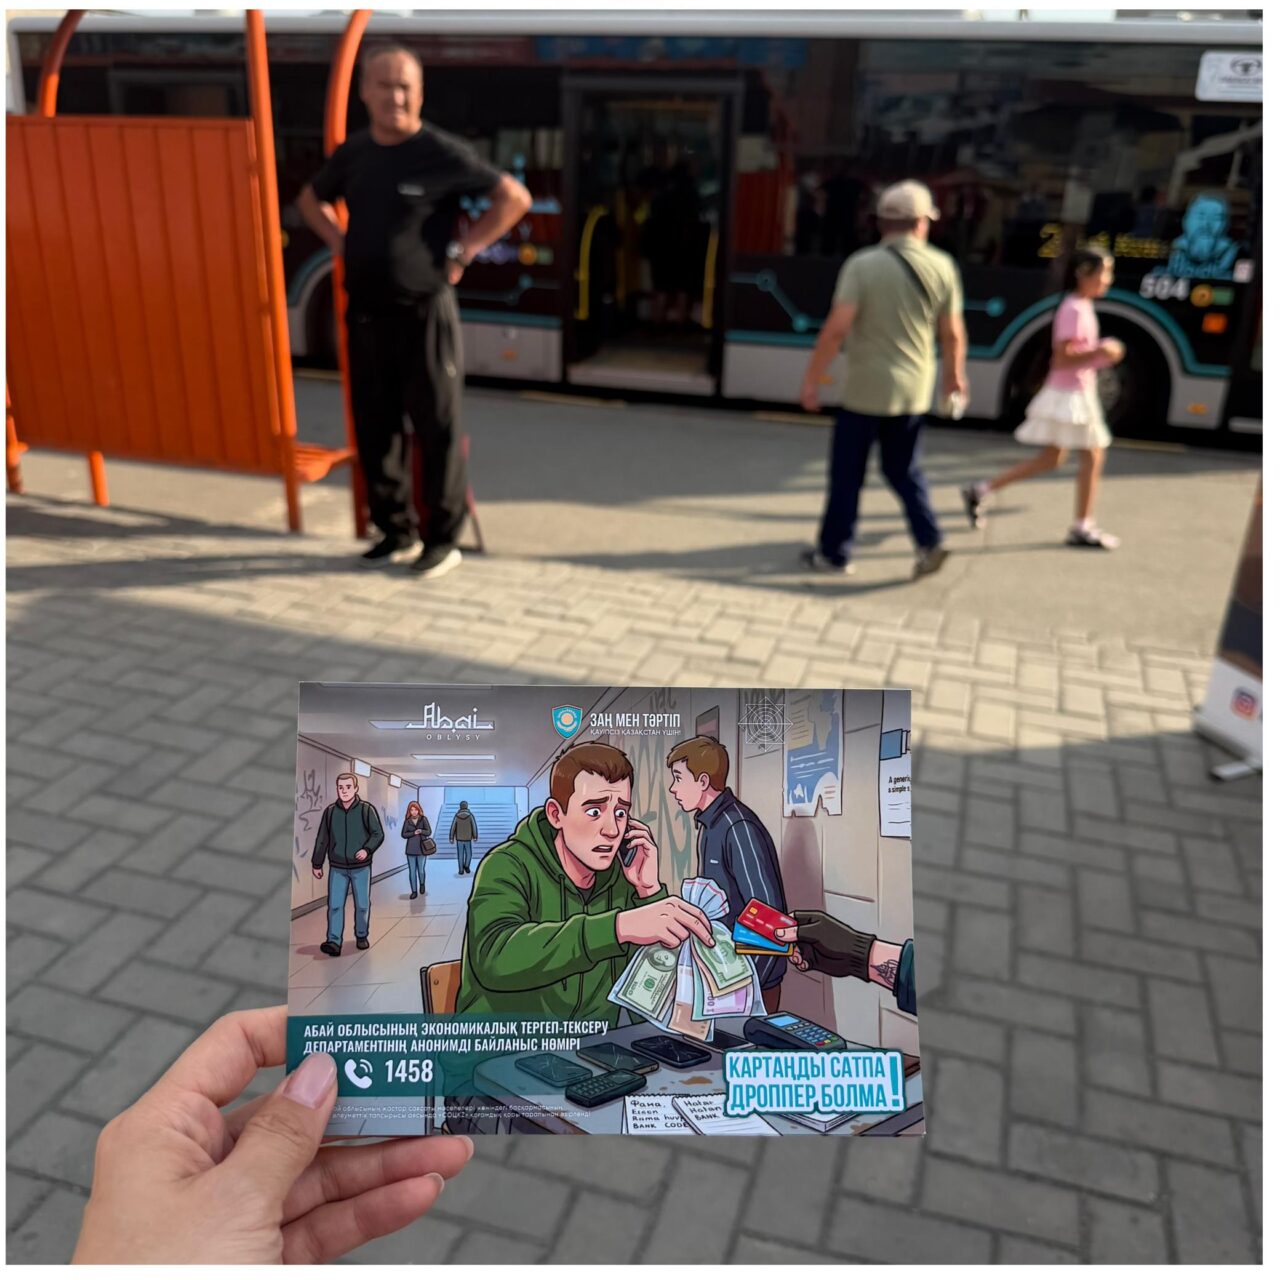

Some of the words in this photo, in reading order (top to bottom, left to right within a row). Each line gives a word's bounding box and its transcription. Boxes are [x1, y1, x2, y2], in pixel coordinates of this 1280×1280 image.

[1139, 272, 1189, 300] 504
[590, 713, 613, 728] ЗАҢ
[615, 713, 640, 727] МЕН
[642, 713, 681, 727] ТӘРТІП
[304, 1023, 335, 1037] АБАЙ
[337, 1022, 418, 1038] ОБЛЫСЫНЫҢ
[421, 1021, 518, 1038] ЭКОНОМИКАЛЫҚ
[520, 1020, 609, 1036] ТЕРГЕП-ТЕКСЕРУ
[303, 1039, 408, 1054] ДЕПАРТАМЕНТІНІҢ
[411, 1038, 471, 1054] АНОНИМДІ
[474, 1037, 538, 1052] БАЙЛАНЫС
[541, 1037, 580, 1051] НӨМІРІ
[384, 1059, 433, 1082] 1458
[729, 1055, 825, 1081] КАРТАҢДЫ
[830, 1056, 886, 1078] САТПА
[731, 1084, 816, 1110] ДРОППЕР
[822, 1084, 887, 1108] БОЛМА
